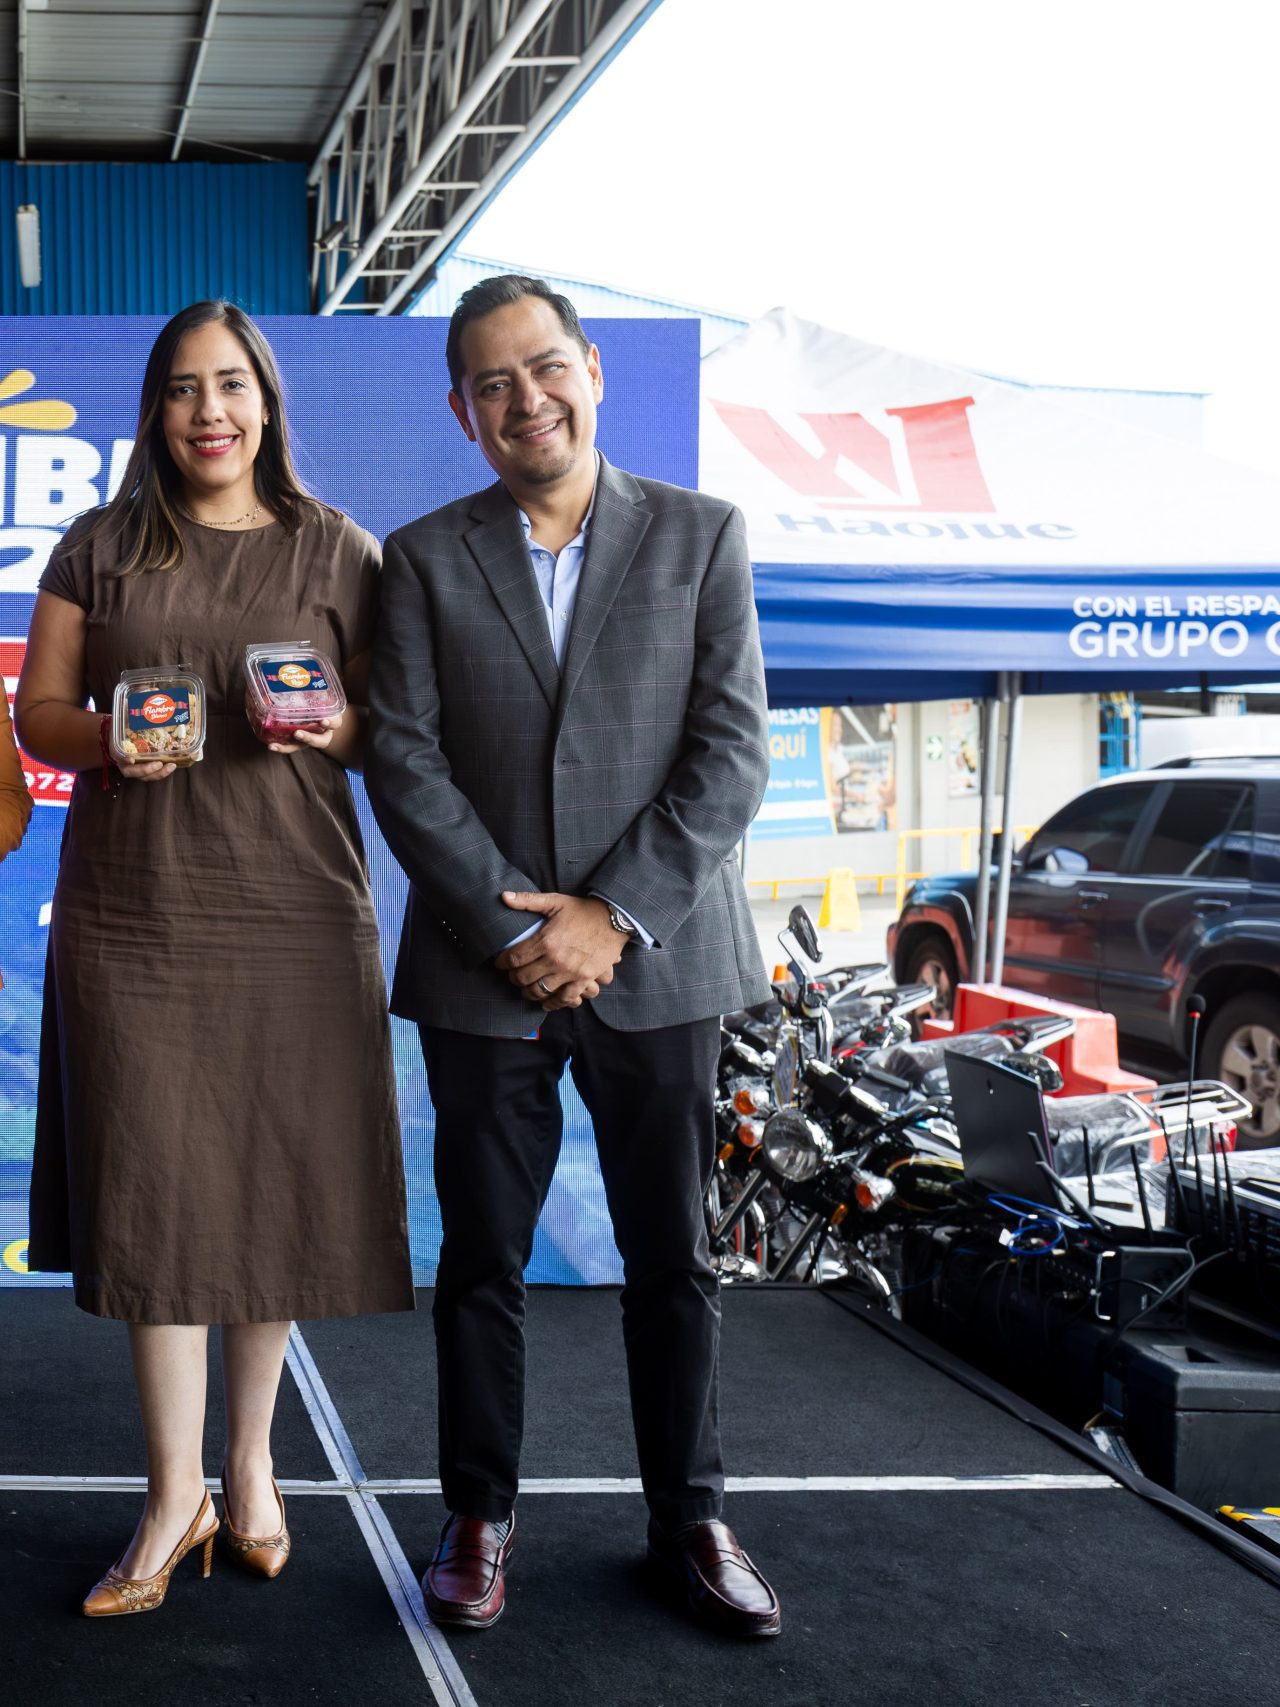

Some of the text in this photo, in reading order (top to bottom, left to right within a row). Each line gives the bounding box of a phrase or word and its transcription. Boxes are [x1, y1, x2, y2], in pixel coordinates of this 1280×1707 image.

[775, 513, 1079, 541] Haojue
[1073, 596, 1137, 618] CON
[1144, 595, 1181, 618] EL
[1068, 620, 1250, 659] GRUPO
